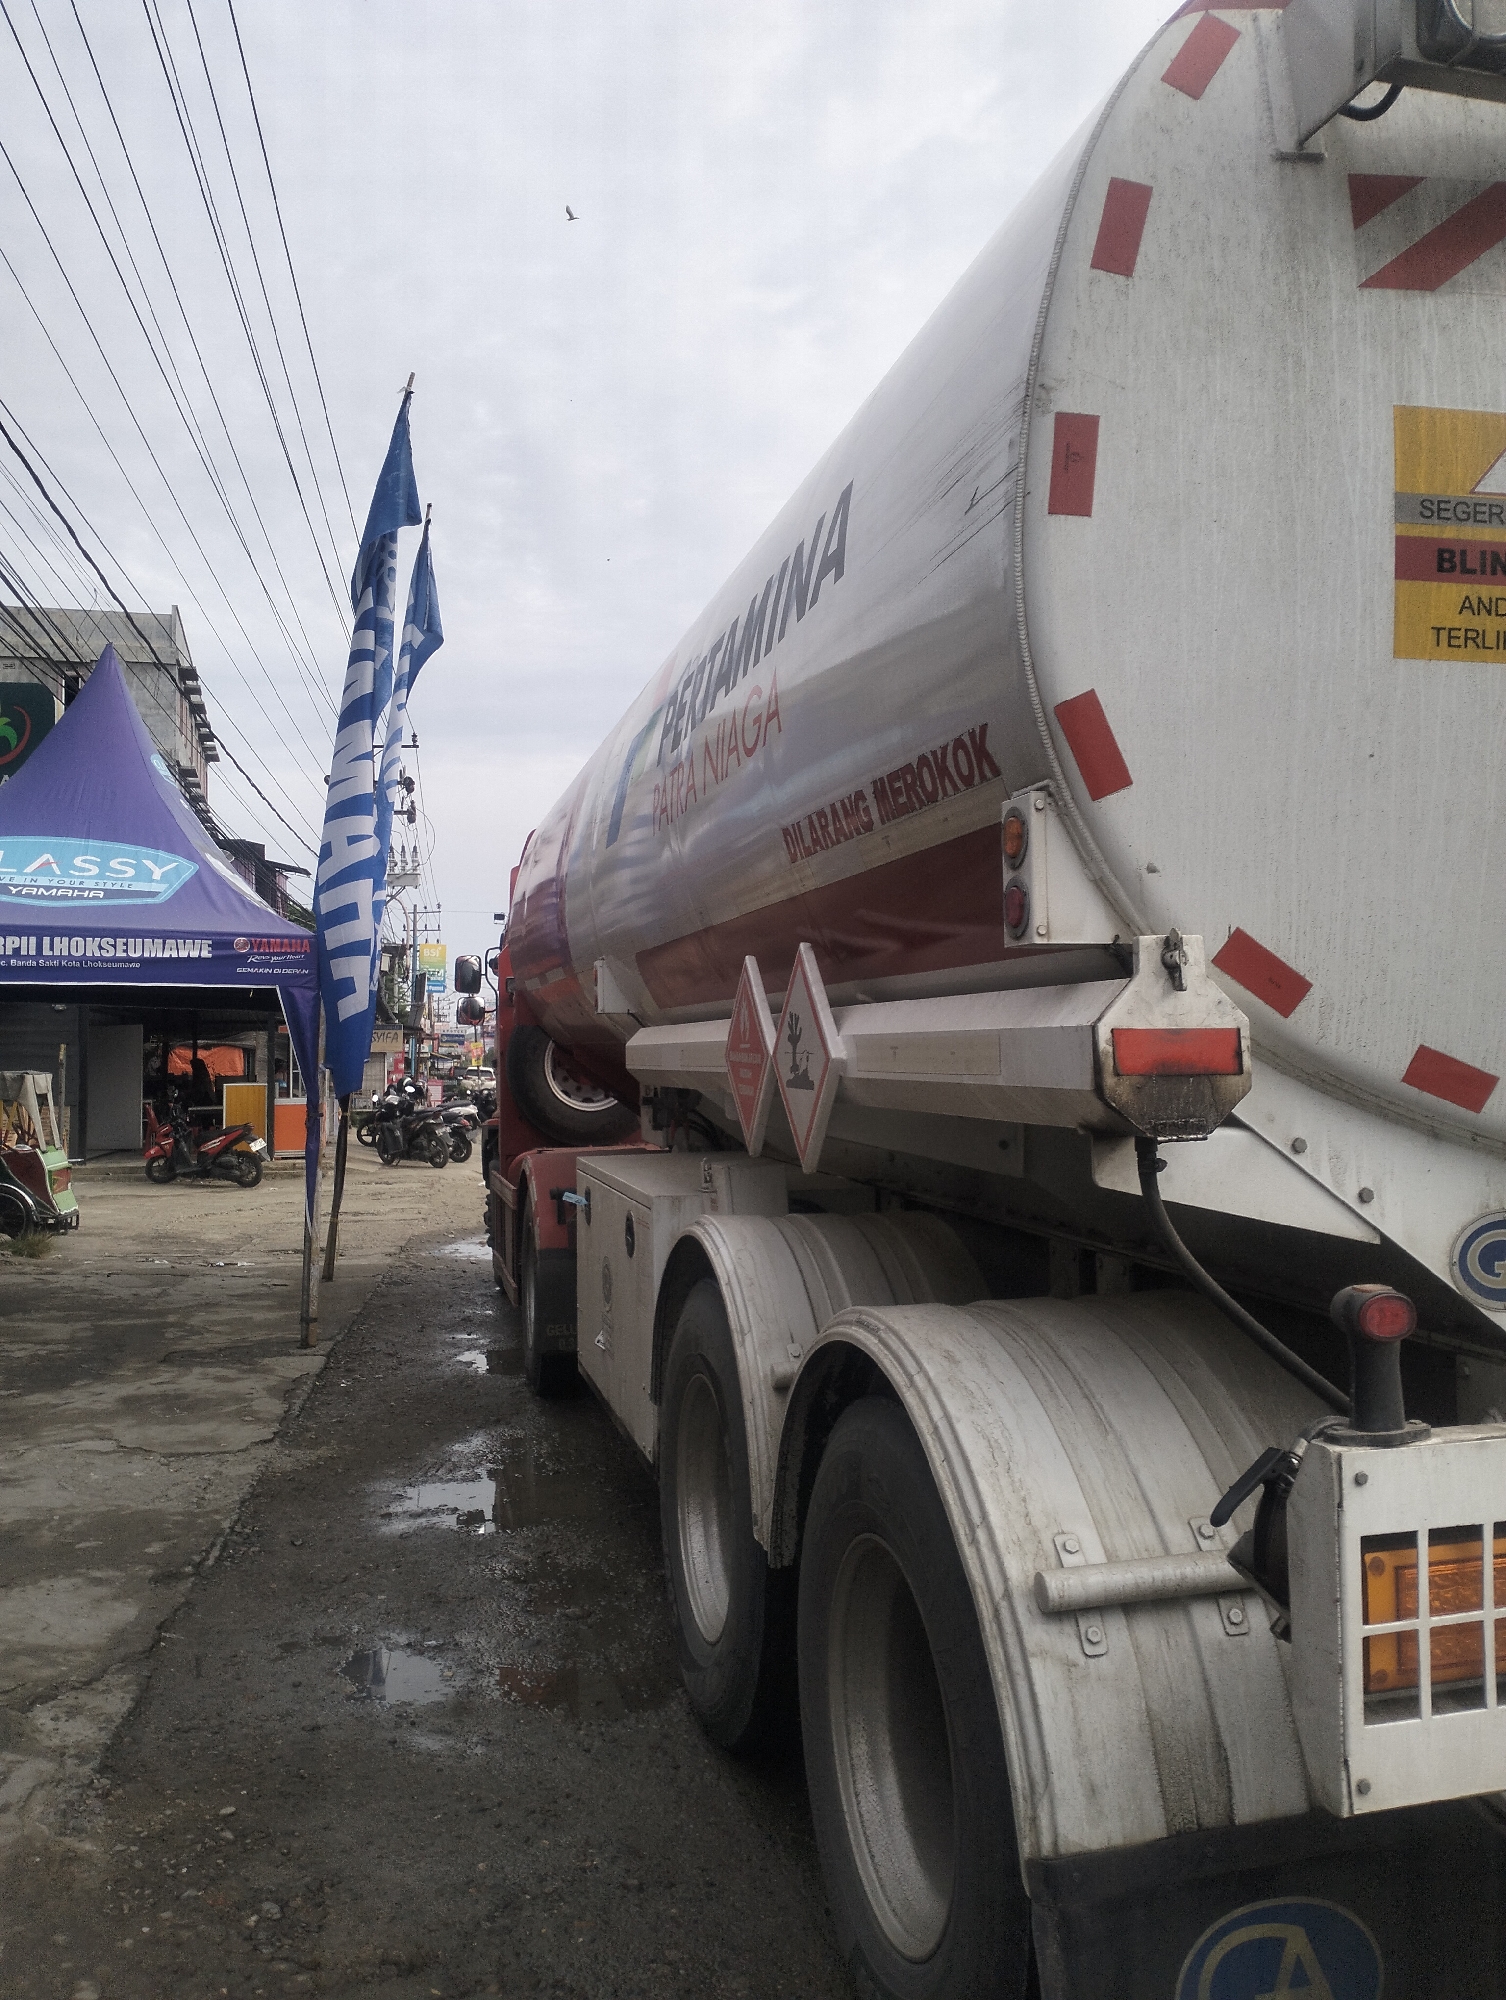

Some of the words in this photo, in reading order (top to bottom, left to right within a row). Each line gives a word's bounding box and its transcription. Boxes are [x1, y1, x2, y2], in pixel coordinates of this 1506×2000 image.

[1436, 548, 1506, 576] BLIN
[656, 478, 854, 768] PERTAMINA
[1431, 626, 1506, 651] TERLI
[652, 749, 698, 837] PATRA
[703, 666, 783, 797] NIAGA
[781, 788, 875, 864] DILARANG
[871, 722, 1002, 826] MEROKOK
[8, 885, 105, 899] YAMAHA
[48, 878, 85, 887] YOUR
[94, 881, 134, 889] STYLE
[42, 936, 213, 959] LHOKSEUMAWE
[251, 937, 311, 953] YAMAHA
[10, 959, 37, 967] Banda
[38, 959, 60, 968] Sakti
[62, 960, 81, 968] Kota
[82, 960, 141, 969] Lhokseumawe
